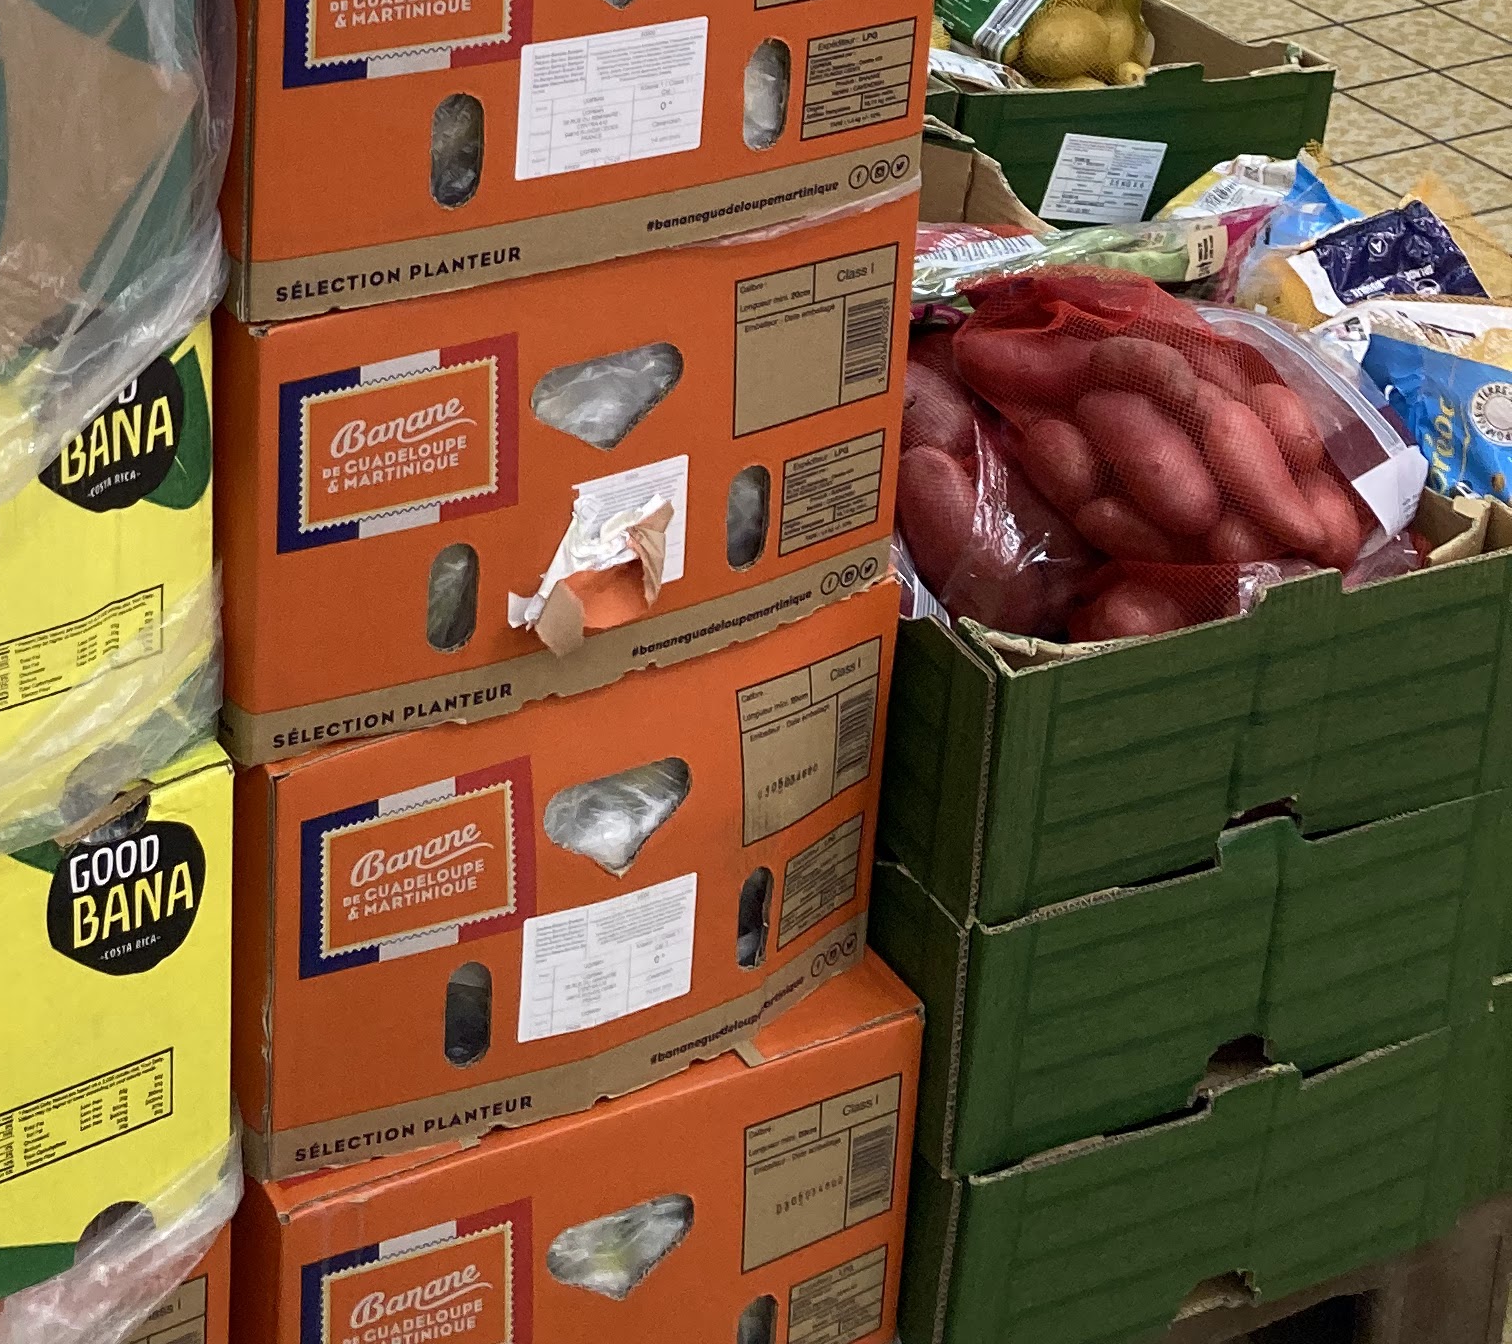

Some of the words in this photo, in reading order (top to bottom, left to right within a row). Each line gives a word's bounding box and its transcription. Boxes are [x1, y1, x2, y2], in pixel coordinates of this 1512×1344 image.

[274, 266, 403, 305] SÉLECTION
[408, 245, 523, 284] PLANTEUR
[329, 395, 478, 461] Banane
[343, 434, 468, 475] GUADELOUPE
[343, 453, 461, 490] MARTINIQUE
[272, 709, 398, 749] SÉLECTION
[403, 682, 514, 722] PLANTEUR
[69, 833, 161, 894] GOOD
[349, 821, 495, 886] Banane
[363, 859, 485, 901] GUADELOUPE
[73, 858, 195, 951] BANA
[363, 876, 479, 917] MARTINIQUE
[295, 1123, 416, 1163] SÉLECTION
[422, 1095, 535, 1134] PLANTEUR
[349, 1263, 494, 1329] Banane
